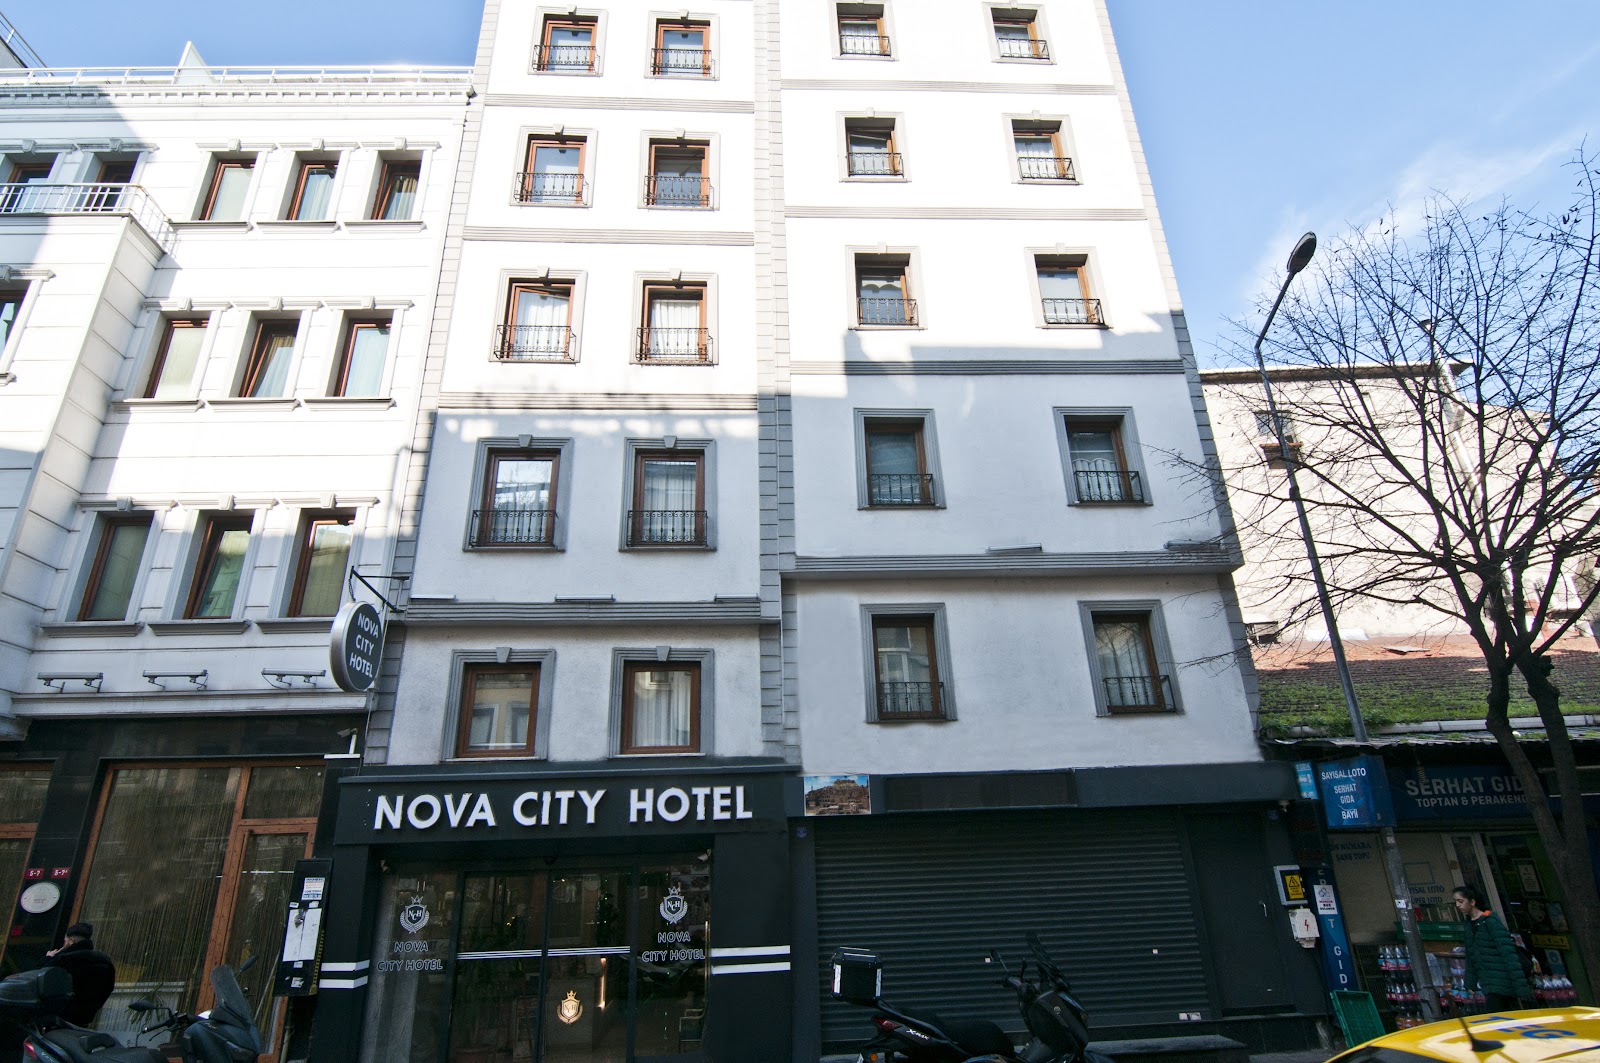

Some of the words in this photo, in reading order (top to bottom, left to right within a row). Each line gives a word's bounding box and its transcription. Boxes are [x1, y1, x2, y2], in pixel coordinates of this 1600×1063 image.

[357, 612, 379, 639] NOVA
[355, 634, 375, 656] CITY
[349, 652, 373, 678] HOTEL
[1321, 769, 1348, 780] SAYISAL
[1347, 767, 1366, 778] LOTO
[1333, 783, 1357, 794] SERHAT
[1405, 776, 1485, 796] SERHAT
[1490, 775, 1526, 793] GID
[1340, 795, 1355, 805] GIDA
[1415, 796, 1459, 808] TOPTAN
[1460, 796, 1469, 806] &
[373, 792, 498, 830] NOVA
[512, 789, 607, 826] CITY
[629, 785, 753, 822] HOTEL
[657, 931, 691, 943] NOVA
[393, 940, 429, 953] NOVA
[641, 950, 668, 962] CITY
[669, 948, 706, 961] HOTEL
[377, 960, 404, 972] CITY
[404, 958, 443, 971] HOTEL
